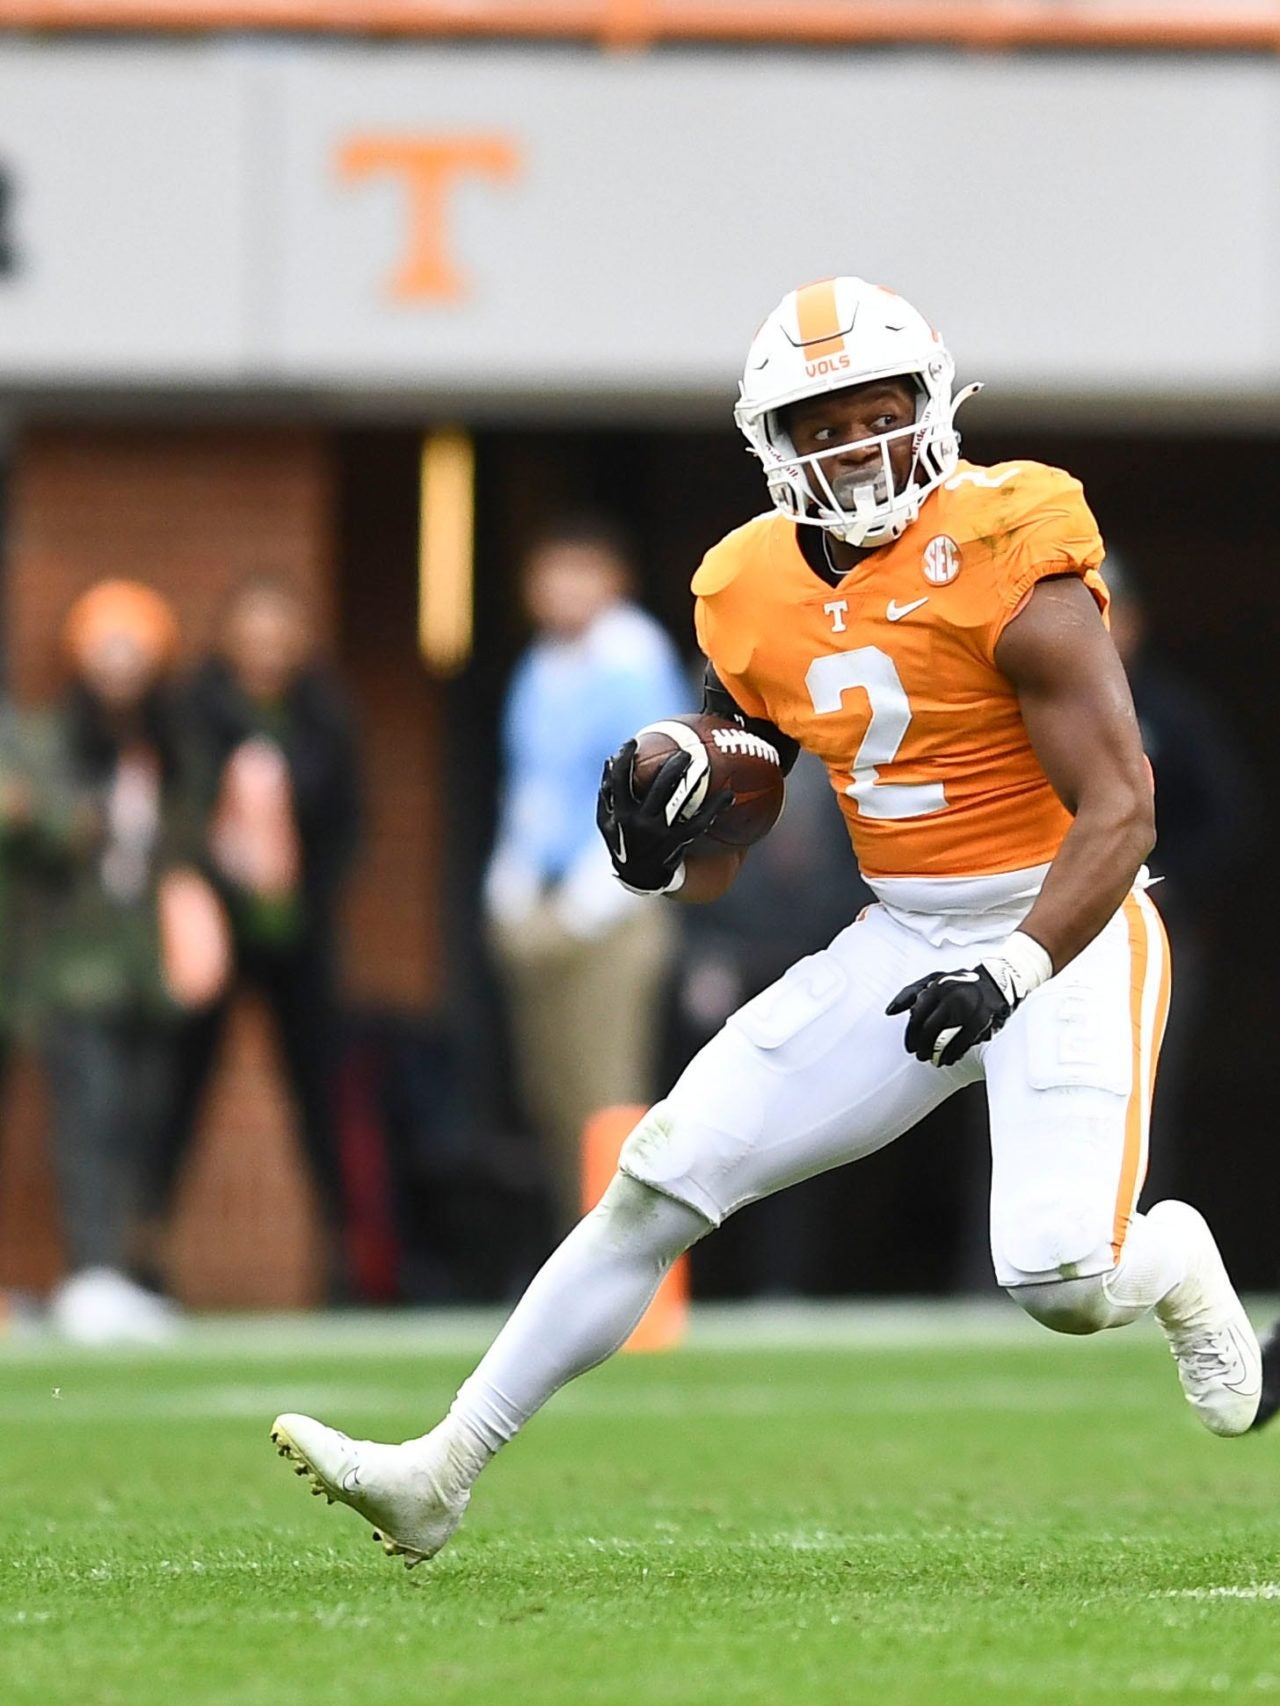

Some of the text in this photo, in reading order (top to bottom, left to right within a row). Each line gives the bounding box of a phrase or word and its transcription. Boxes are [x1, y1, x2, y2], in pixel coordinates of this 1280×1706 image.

[331, 131, 523, 305] T
[804, 355, 851, 378] VOLS
[922, 536, 961, 583] SEC
[823, 600, 849, 633] T
[804, 645, 949, 820] 2
